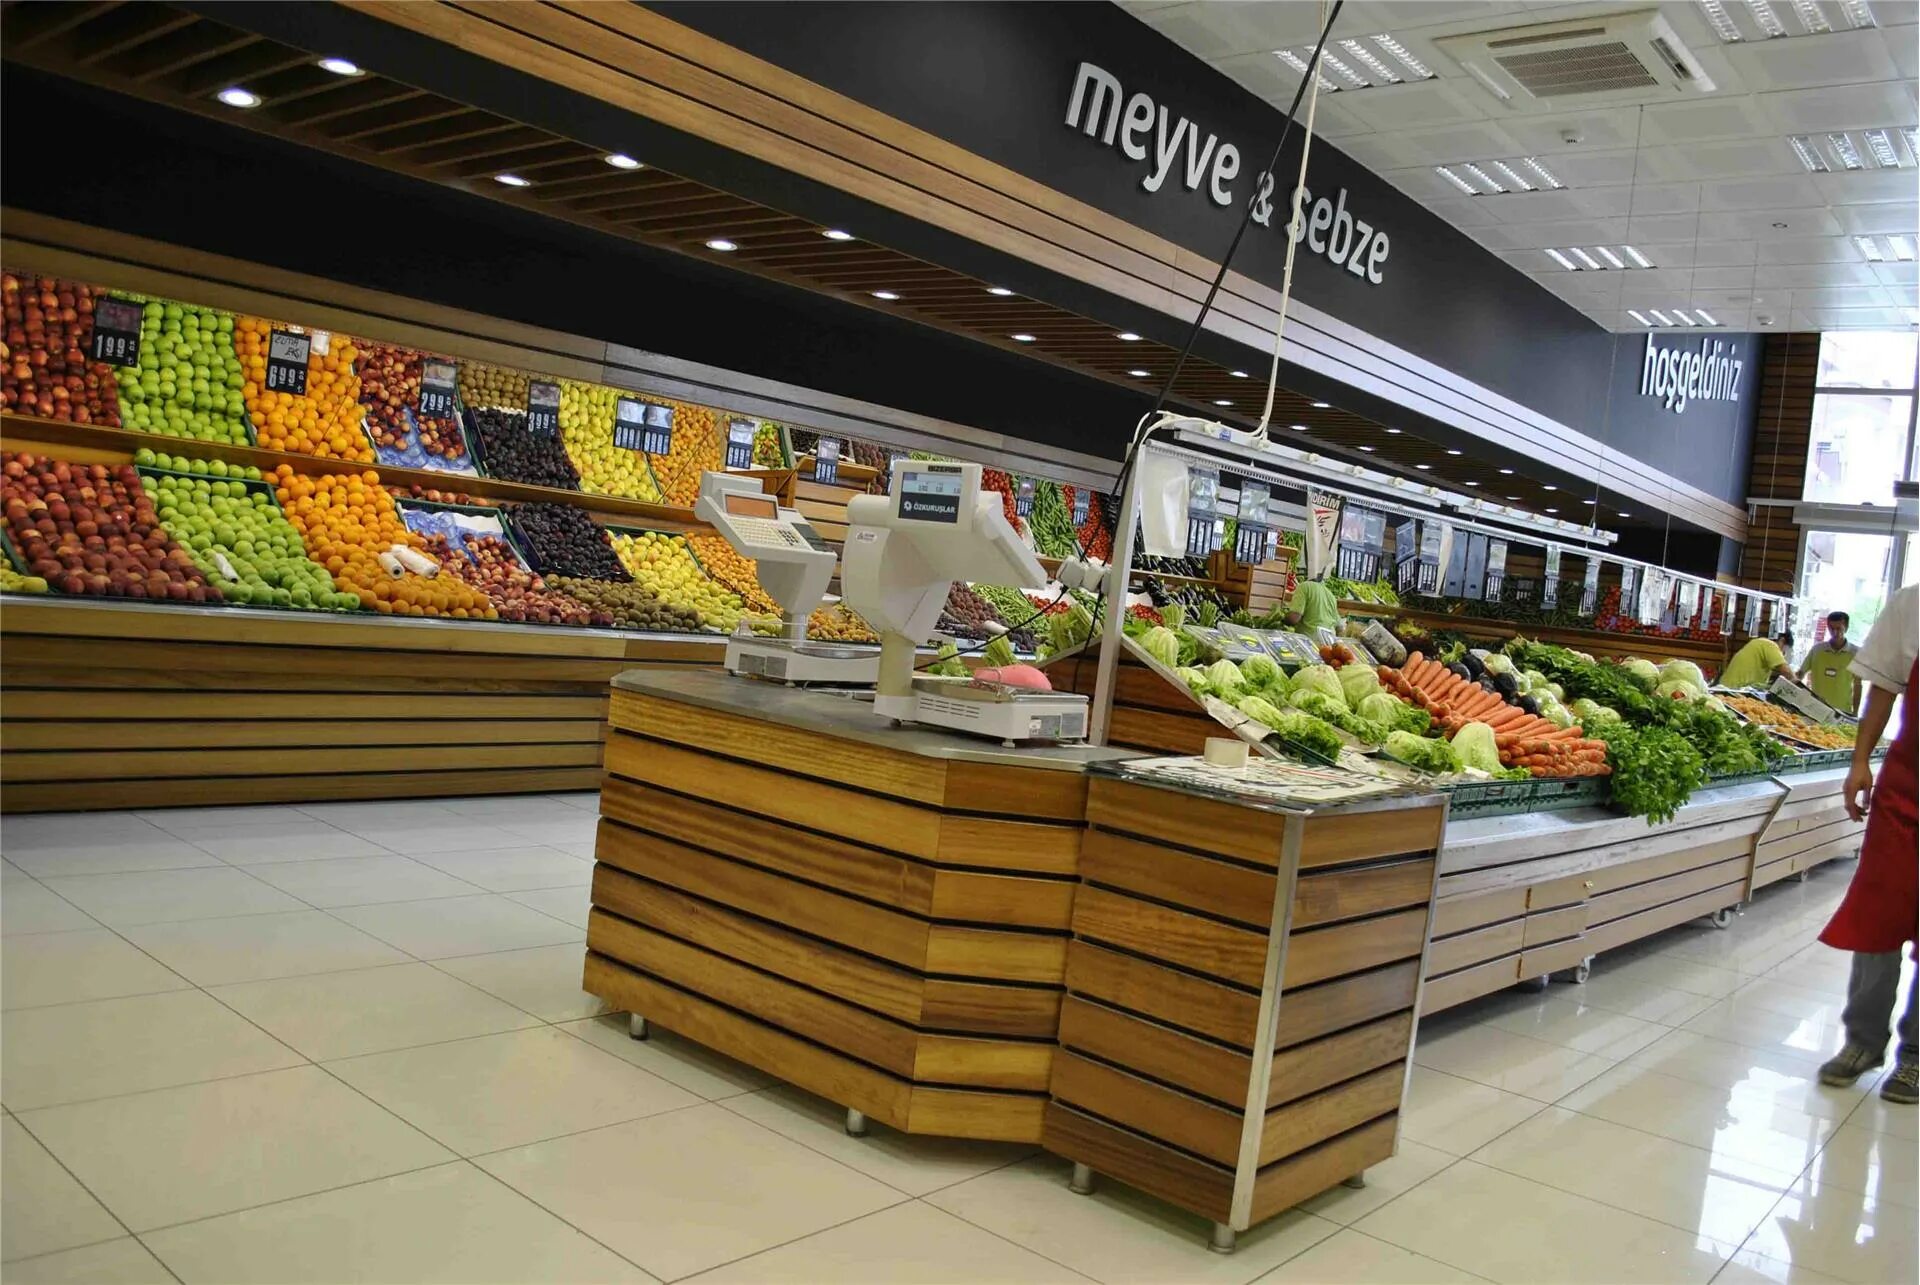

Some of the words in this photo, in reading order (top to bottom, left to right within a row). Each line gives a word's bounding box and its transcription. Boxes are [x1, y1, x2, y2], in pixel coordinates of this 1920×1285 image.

[1064, 61, 1240, 206] meyve
[1249, 171, 1274, 227] &
[1285, 186, 1390, 285] sebze
[97, 334, 126, 359] 199
[268, 365, 296, 388] 699
[1641, 331, 1743, 414] hoşgeldiniz
[420, 392, 445, 413] 299
[528, 412, 550, 433] 399
[913, 501, 956, 514] ÖZKURUŞLAR
